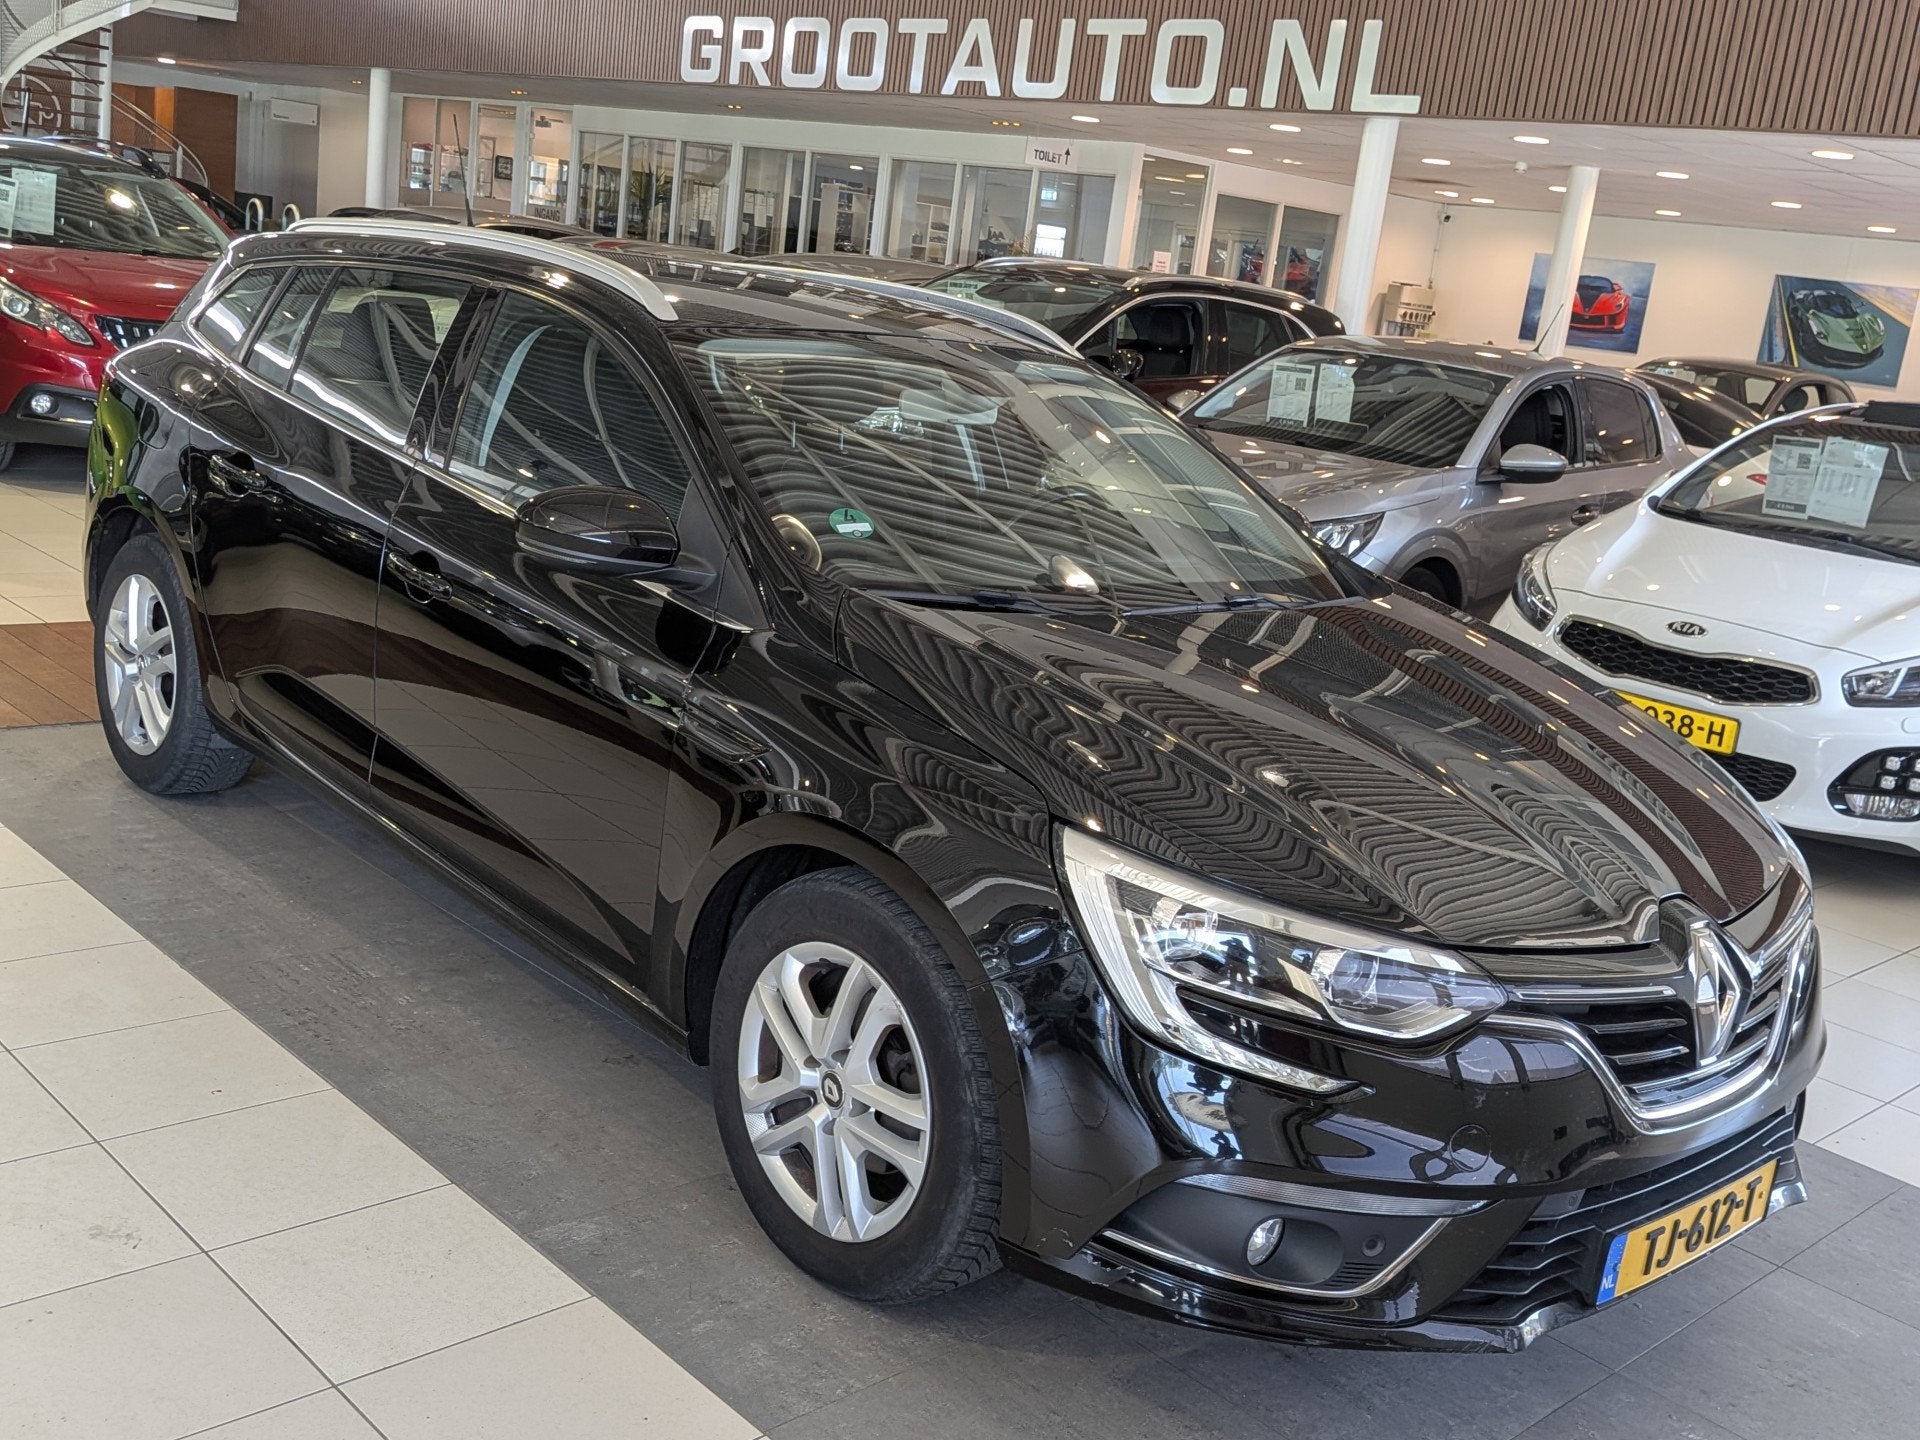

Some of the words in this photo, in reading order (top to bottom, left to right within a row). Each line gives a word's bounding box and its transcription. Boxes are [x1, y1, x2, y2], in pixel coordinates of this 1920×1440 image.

[681, 16, 1421, 115] GROOTAUTO.NL
[1034, 149, 1062, 164] TOILET
[844, 509, 856, 523] 4
[1672, 622, 1700, 635] KIA
[1642, 1176, 1763, 1276] TJ-612-T
[1600, 1274, 1614, 1291] NL
